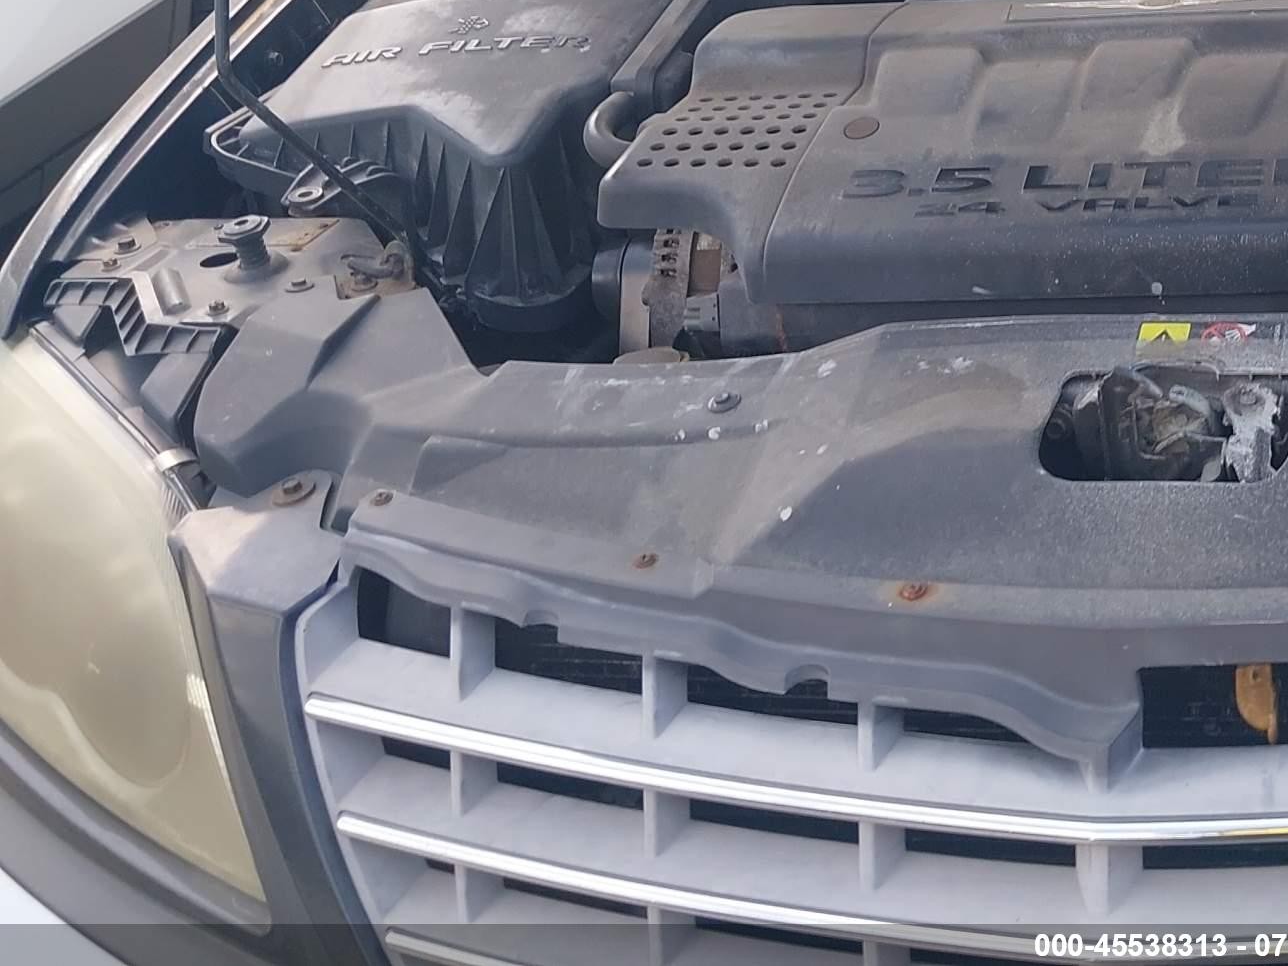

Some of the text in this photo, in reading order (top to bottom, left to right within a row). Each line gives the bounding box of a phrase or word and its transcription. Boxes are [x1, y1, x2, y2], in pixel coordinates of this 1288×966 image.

[321, 33, 592, 68] AIR FILTER
[841, 165, 993, 199] 3.5
[914, 194, 1258, 218] 24 VALVE
